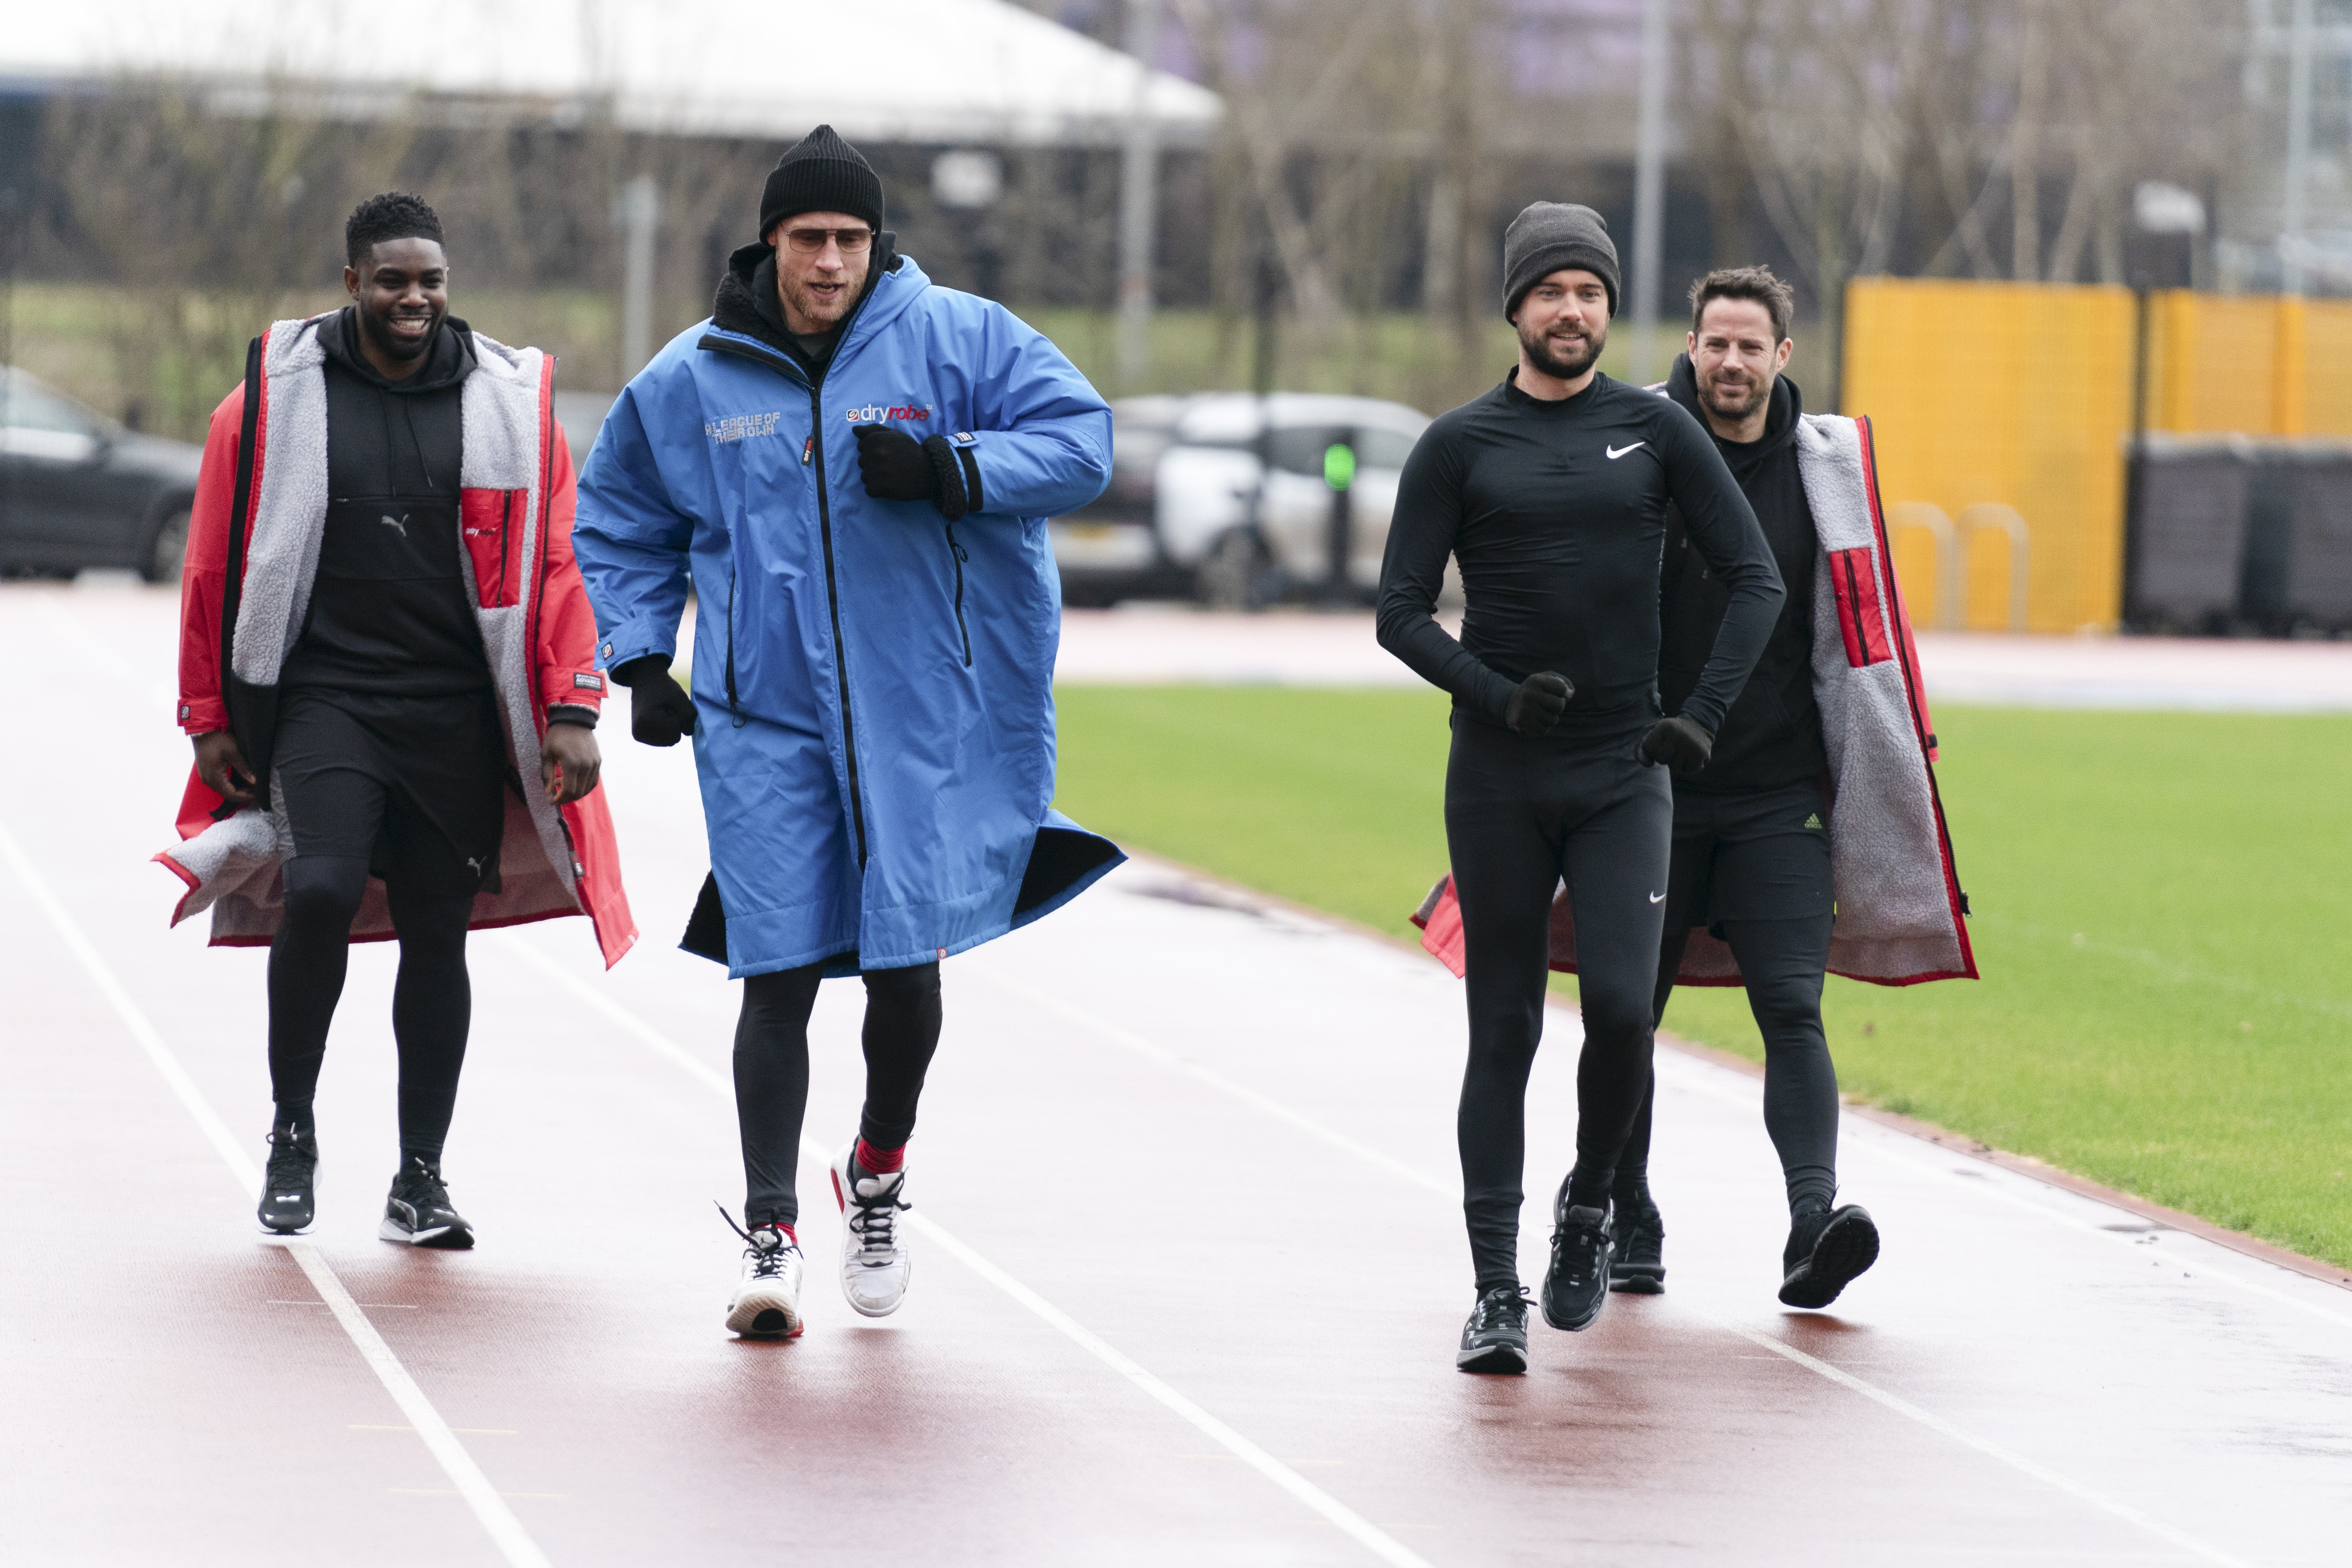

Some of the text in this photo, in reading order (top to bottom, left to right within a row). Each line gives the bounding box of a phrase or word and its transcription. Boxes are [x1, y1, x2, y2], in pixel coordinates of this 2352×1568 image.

[705, 412, 780, 435] A LEAGUE OF
[860, 404, 929, 424] dryrobe
[712, 423, 774, 444] THEIR OWN
